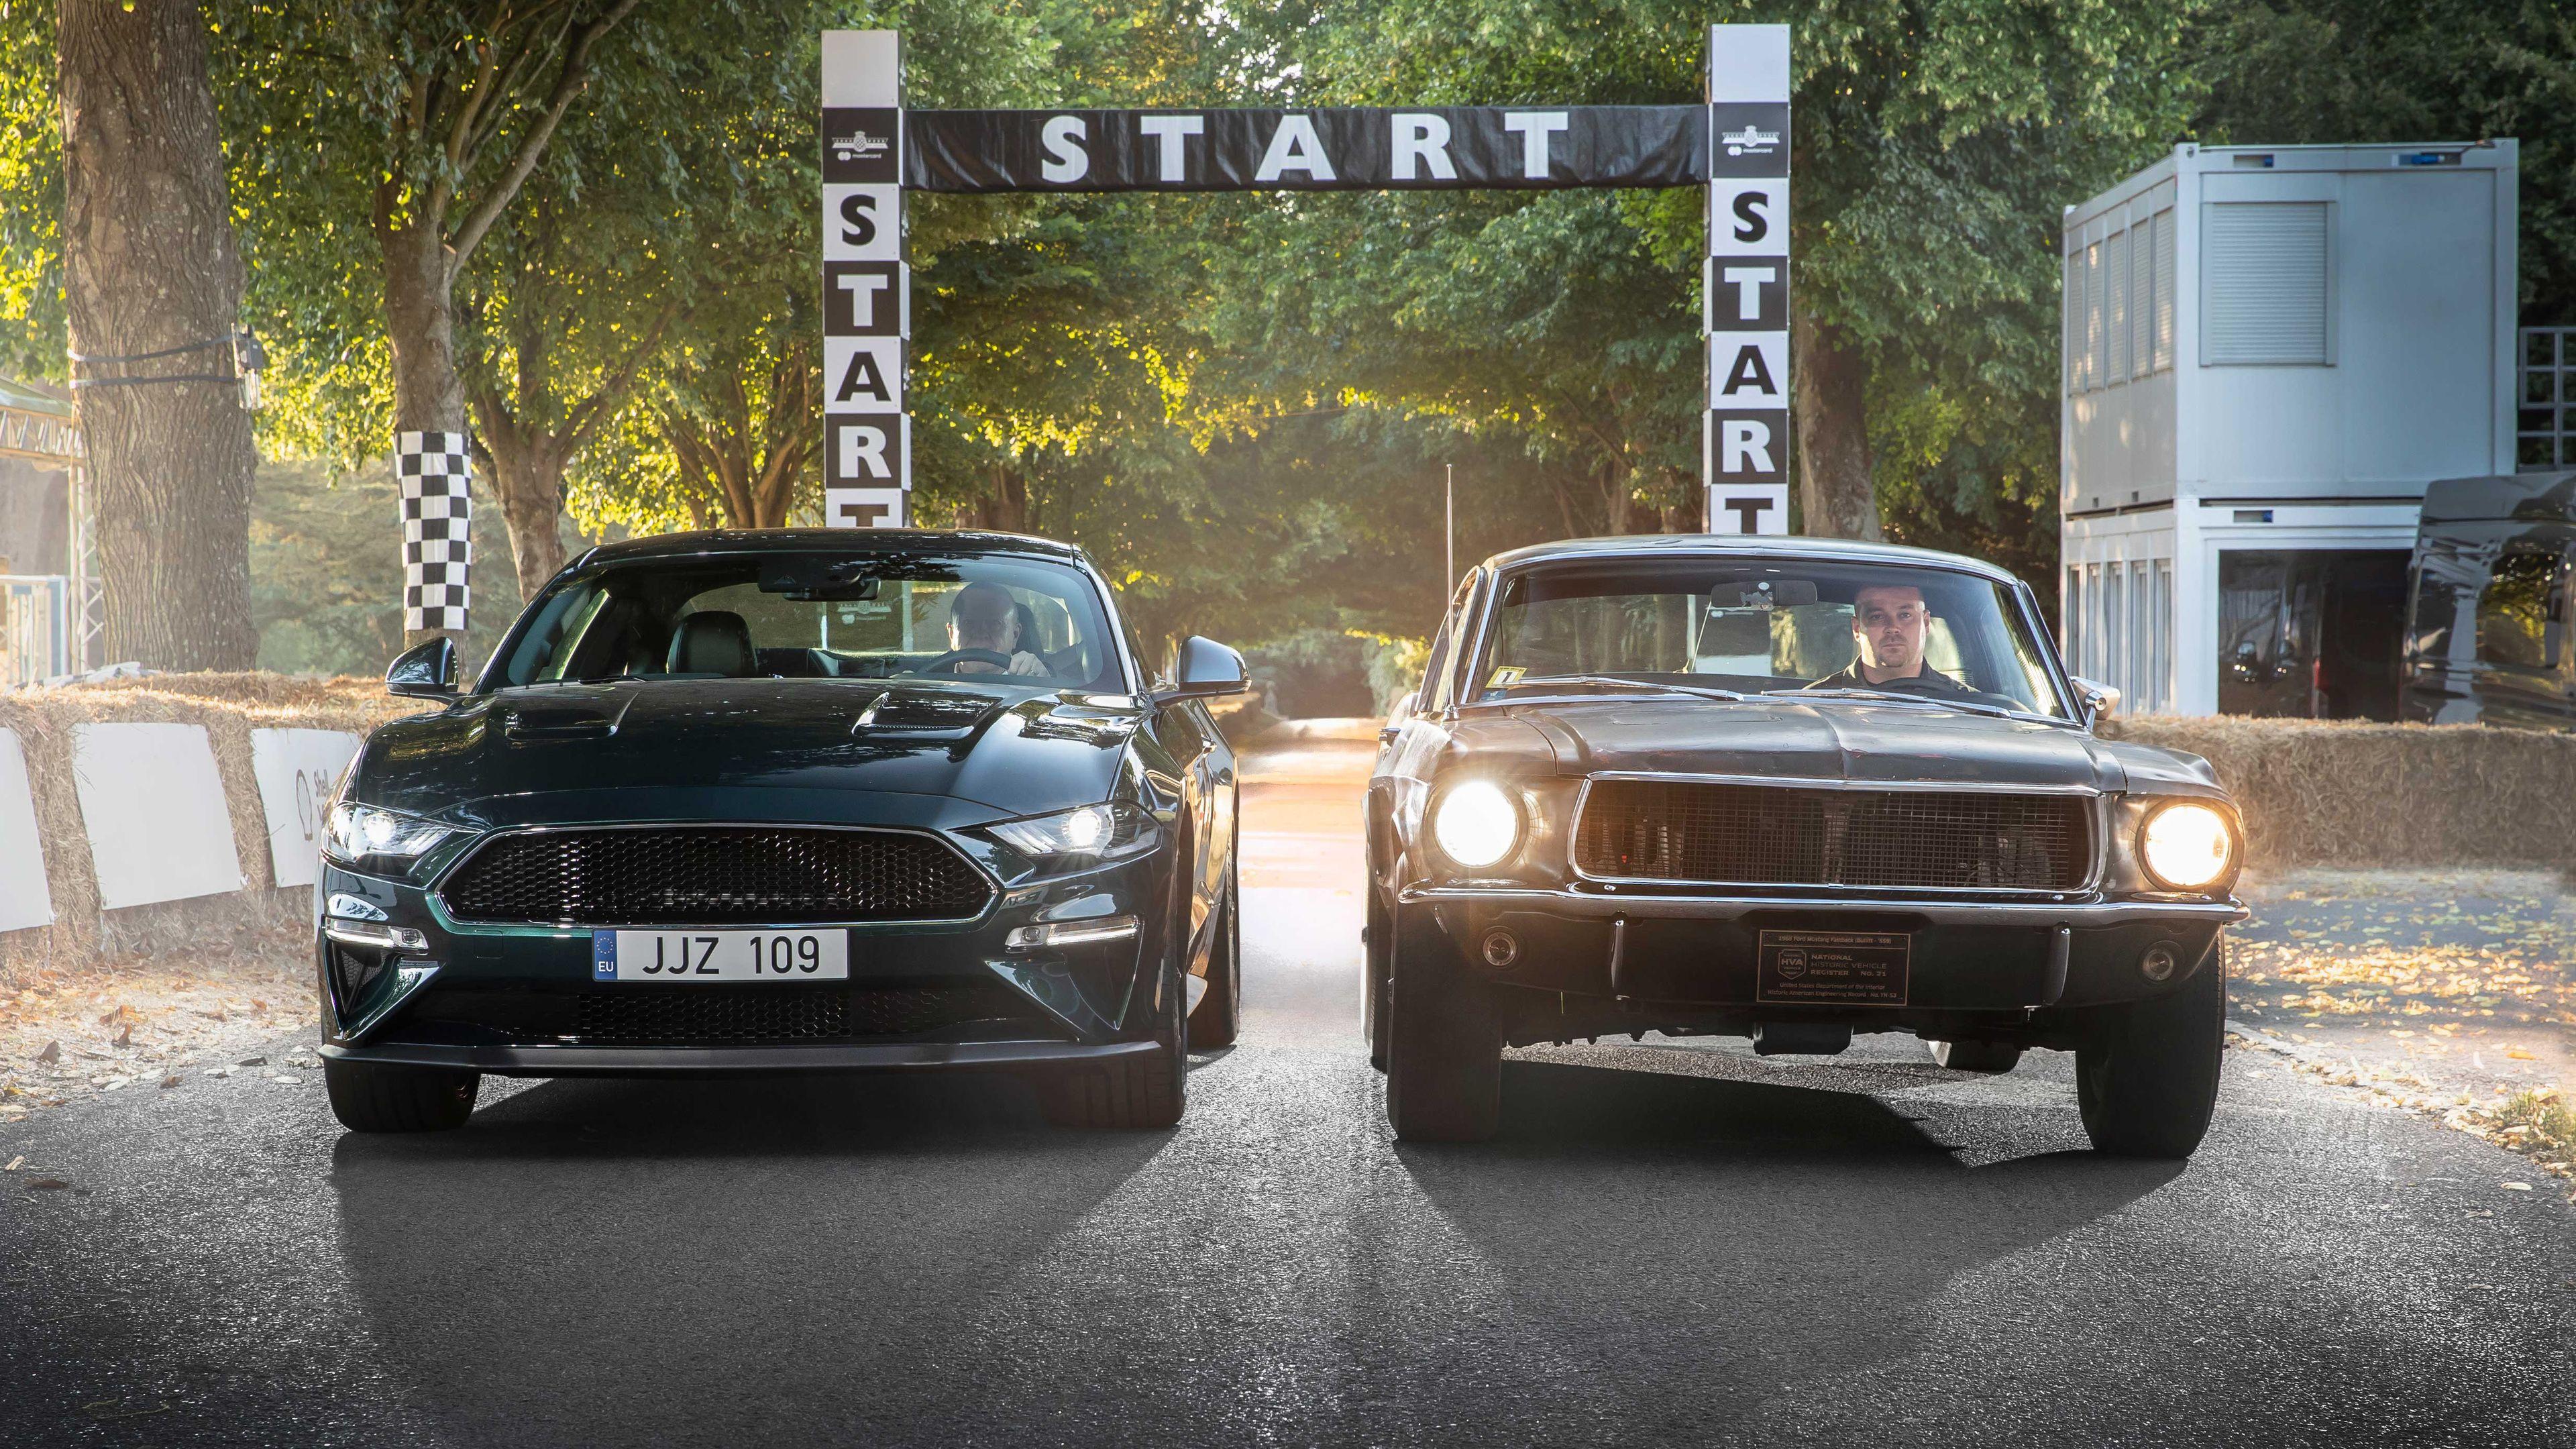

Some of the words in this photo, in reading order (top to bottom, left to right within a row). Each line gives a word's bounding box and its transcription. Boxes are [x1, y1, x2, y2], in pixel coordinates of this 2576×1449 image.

[1041, 111, 1568, 184] START
[598, 961, 614, 972] EU
[642, 936, 720, 975] JJZ
[750, 935, 820, 974] 109
[1781, 958, 1804, 966] HVA
